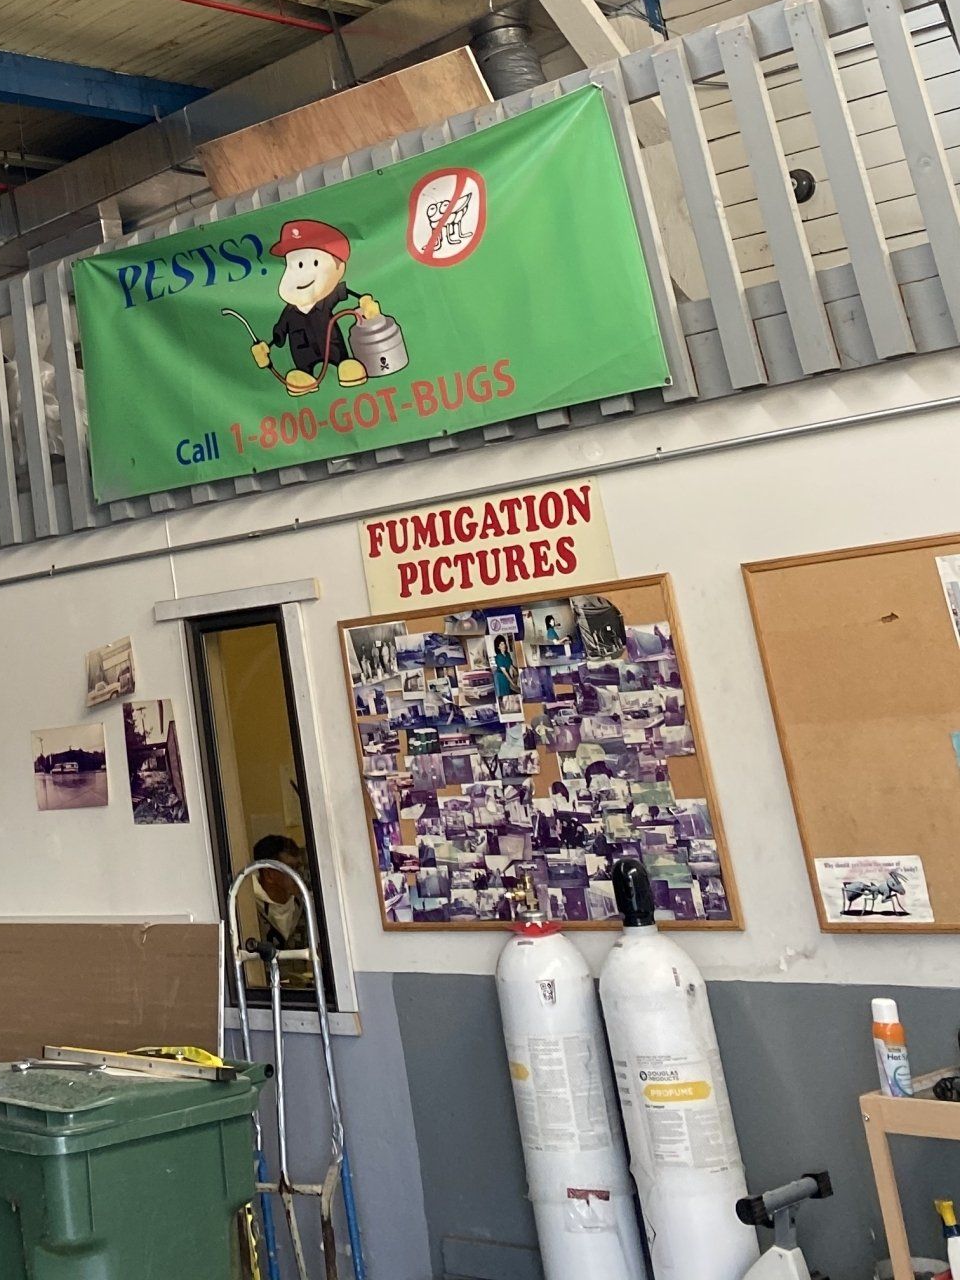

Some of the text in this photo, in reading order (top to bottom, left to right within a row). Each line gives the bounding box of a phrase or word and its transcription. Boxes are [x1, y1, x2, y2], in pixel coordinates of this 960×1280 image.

[116, 233, 269, 310] PESTS?
[176, 359, 517, 466] Call 1-800-GOT-BUGS
[366, 485, 591, 558] FUMIGATION
[397, 536, 577, 598] PICTURES
[650, 1088, 693, 1097] PROFUME
